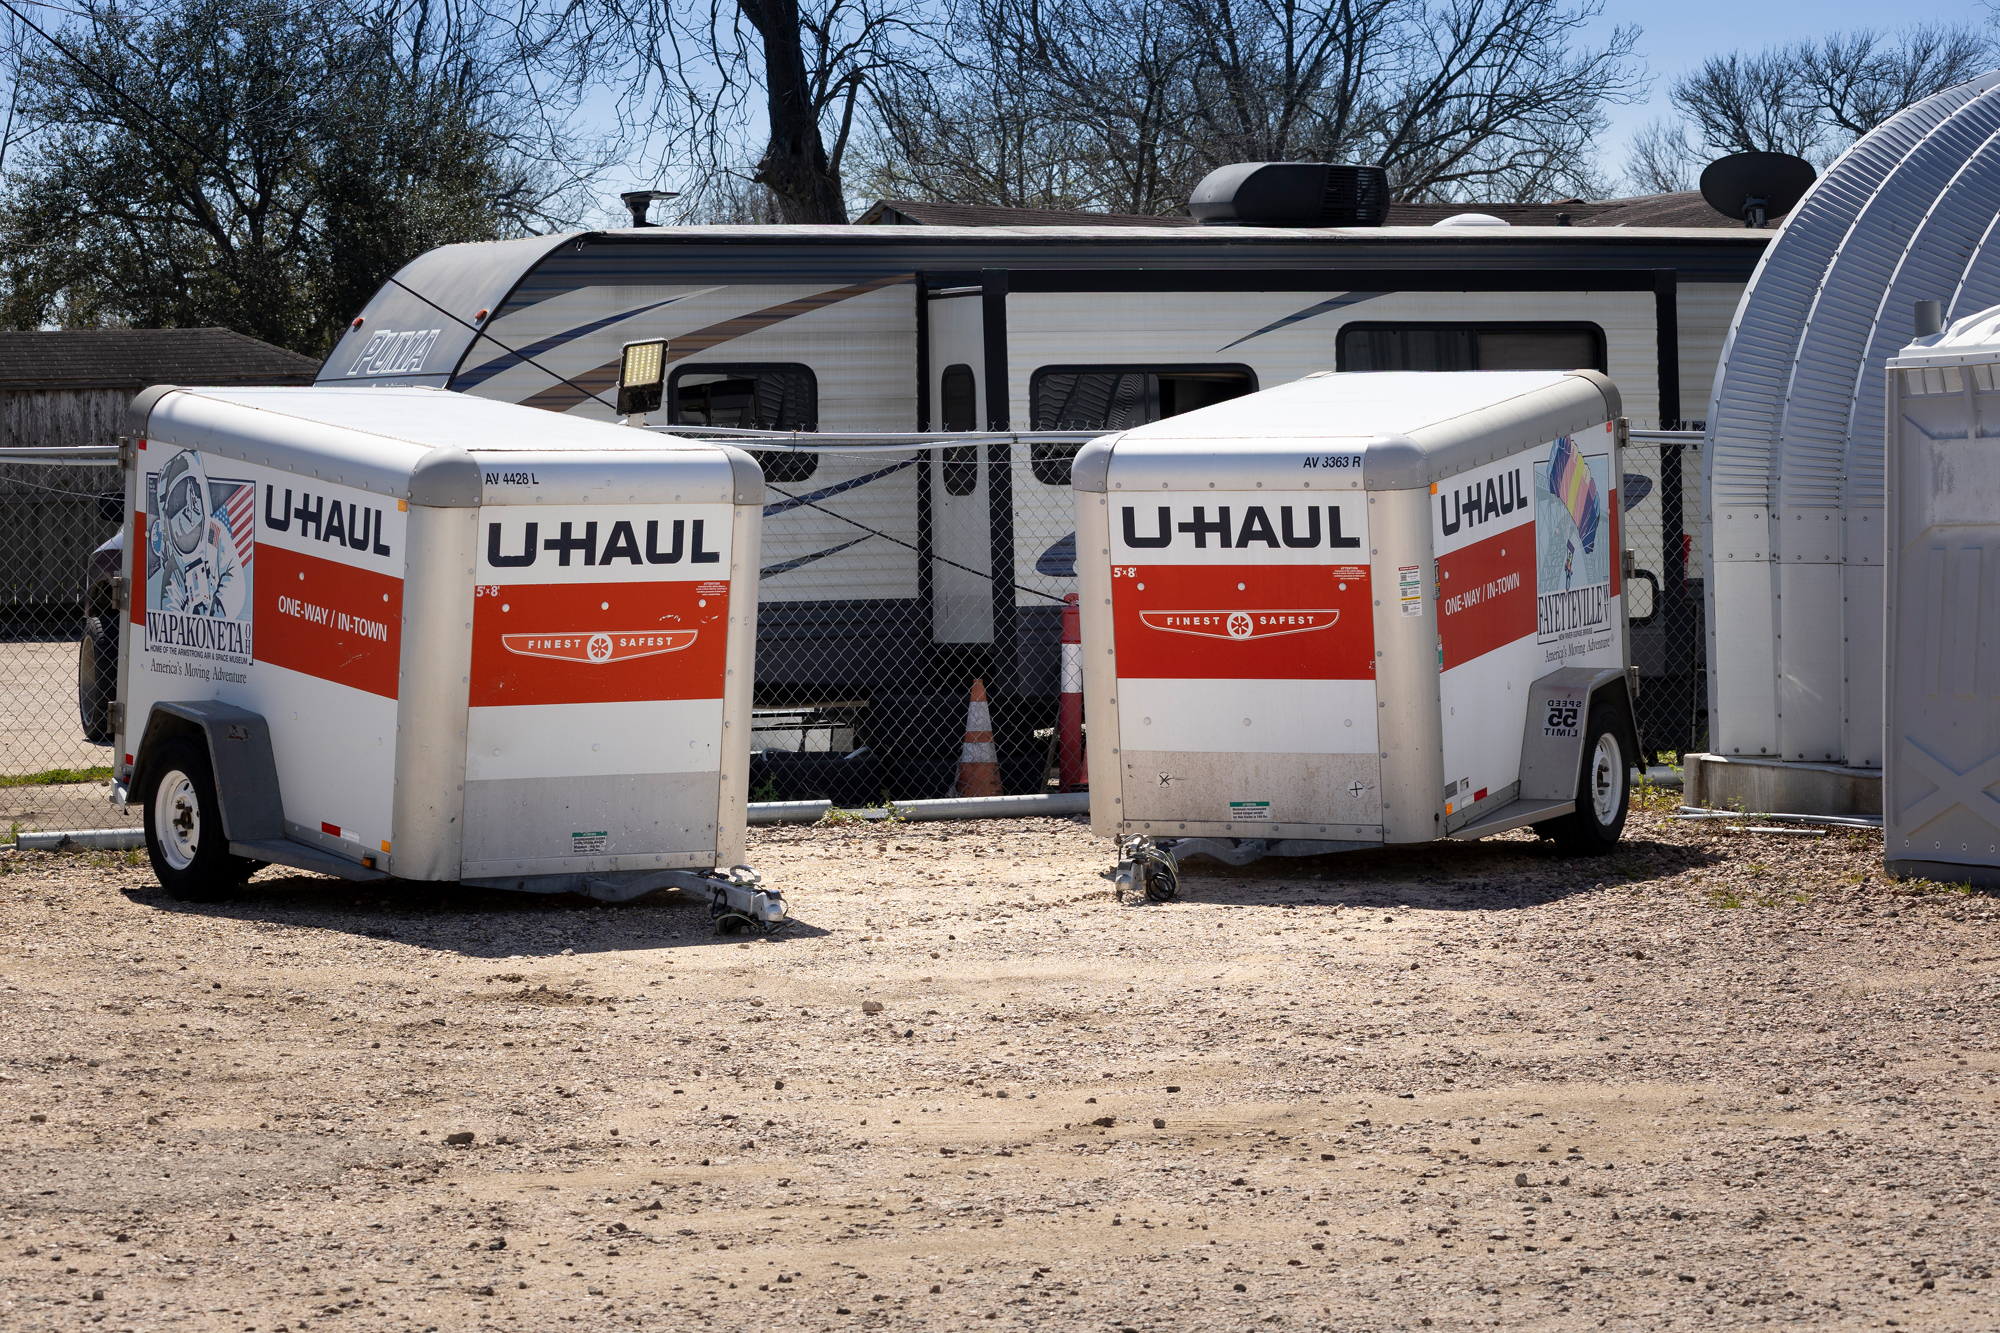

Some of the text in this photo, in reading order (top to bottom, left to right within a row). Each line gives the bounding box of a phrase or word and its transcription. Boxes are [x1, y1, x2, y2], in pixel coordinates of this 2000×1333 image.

[346, 329, 441, 375] PUMA
[485, 473, 539, 485] AV 4428 L
[1303, 456, 1361, 468] AV 3363 R
[265, 484, 391, 558] U-HAUL
[1440, 468, 1528, 537] U-HAUL
[488, 519, 720, 567] U-HAUL
[1122, 505, 1360, 548] U-HAUL
[1445, 587, 1481, 616] ONE-WAY
[1487, 572, 1520, 599] IN-TOWN
[1538, 585, 1602, 635] FAYETTEVILLE
[147, 612, 244, 654] WAPAKONETA
[278, 595, 387, 642] ONE-WAY / IN-TOWN
[1166, 616, 1315, 626] FINEST SAFEST
[150, 644, 162, 653] HOME
[163, 646, 169, 654] OF
[169, 647, 177, 655] THE
[178, 648, 203, 659] ARMSTRONG
[215, 653, 229, 662] SPACE
[229, 655, 247, 665] MUSEUM
[528, 636, 673, 649] FINEST SAFEST
[1545, 638, 1610, 663] America's Moving Adventure
[150, 658, 247, 684] America's Moving Adventure
